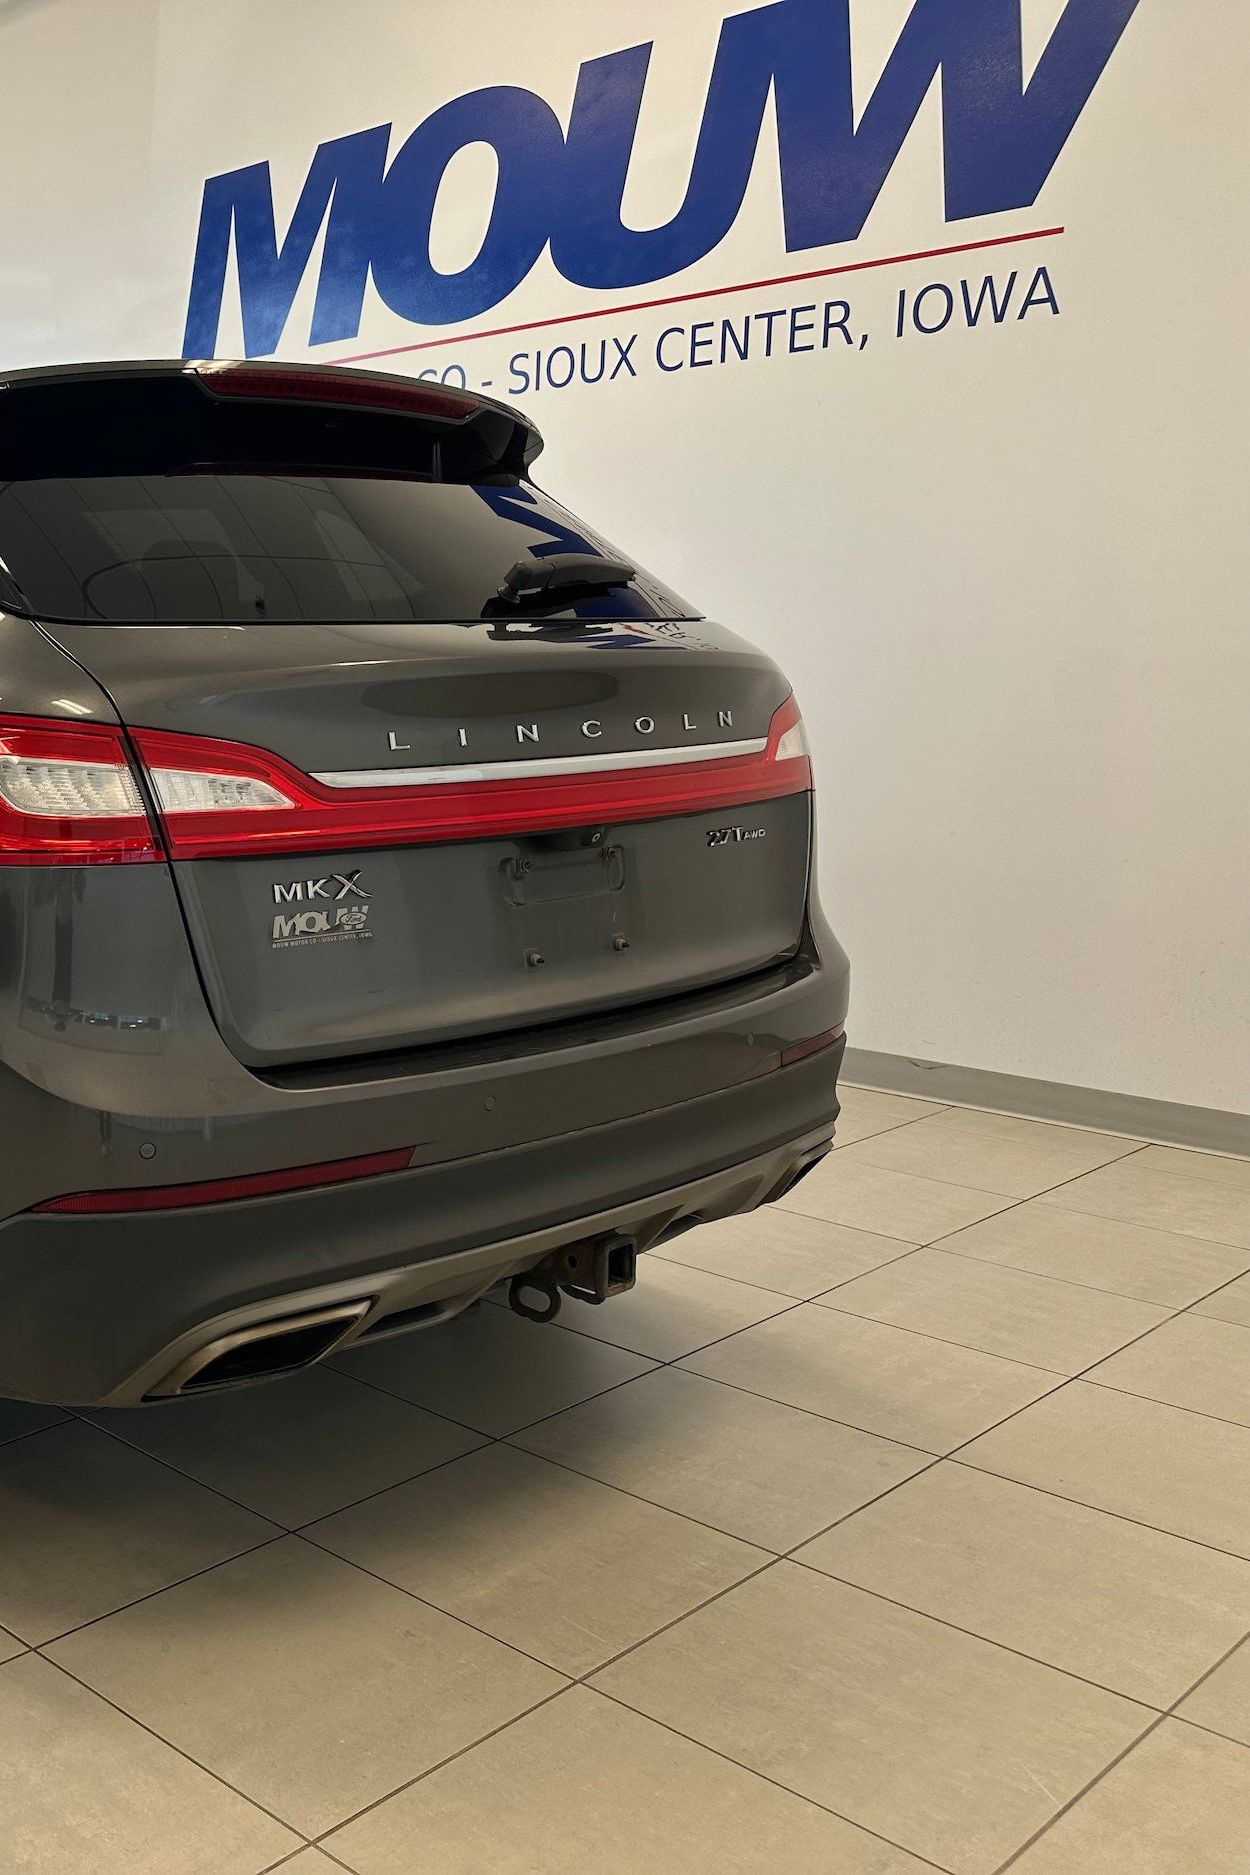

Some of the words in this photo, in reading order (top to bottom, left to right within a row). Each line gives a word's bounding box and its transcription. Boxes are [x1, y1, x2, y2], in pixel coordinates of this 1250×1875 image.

[181, 0, 1138, 360] MOUW
[418, 364, 467, 390] O
[508, 334, 638, 395] SIOUX
[654, 299, 869, 373] CENTER,
[895, 266, 1060, 338] IOWA
[387, 710, 734, 751] LINCOLN
[272, 869, 374, 904] MKX
